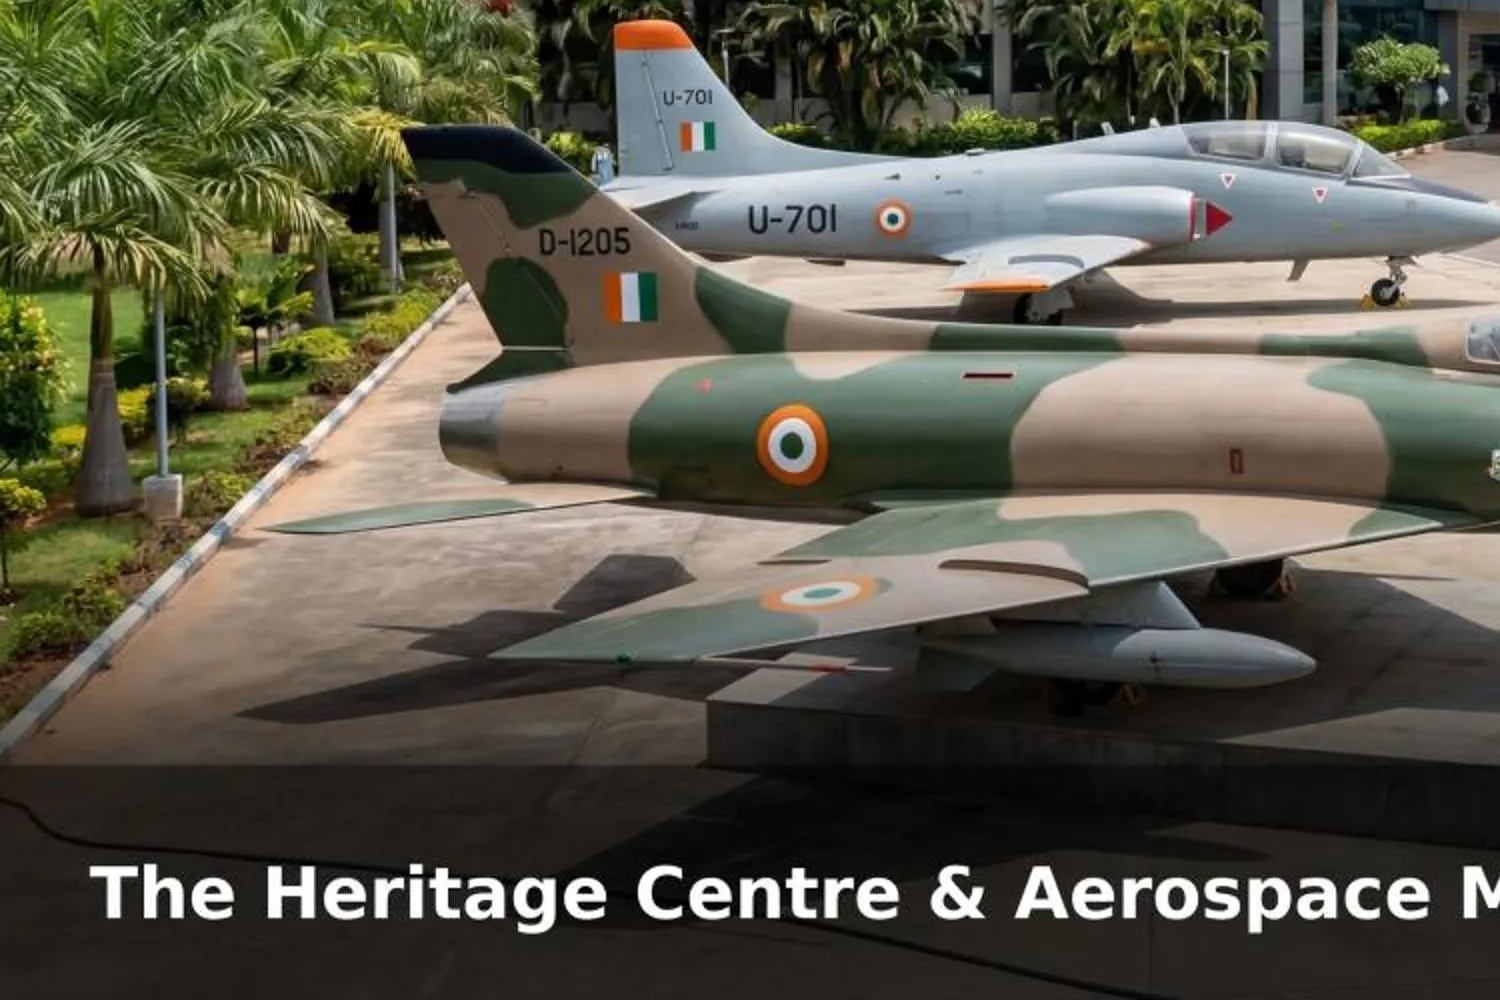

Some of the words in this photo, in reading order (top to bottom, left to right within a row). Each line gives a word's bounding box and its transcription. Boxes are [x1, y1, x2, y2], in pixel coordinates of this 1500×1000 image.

[663, 89, 713, 106] U-701
[749, 204, 837, 235] U-701
[539, 227, 631, 257] D-1205
